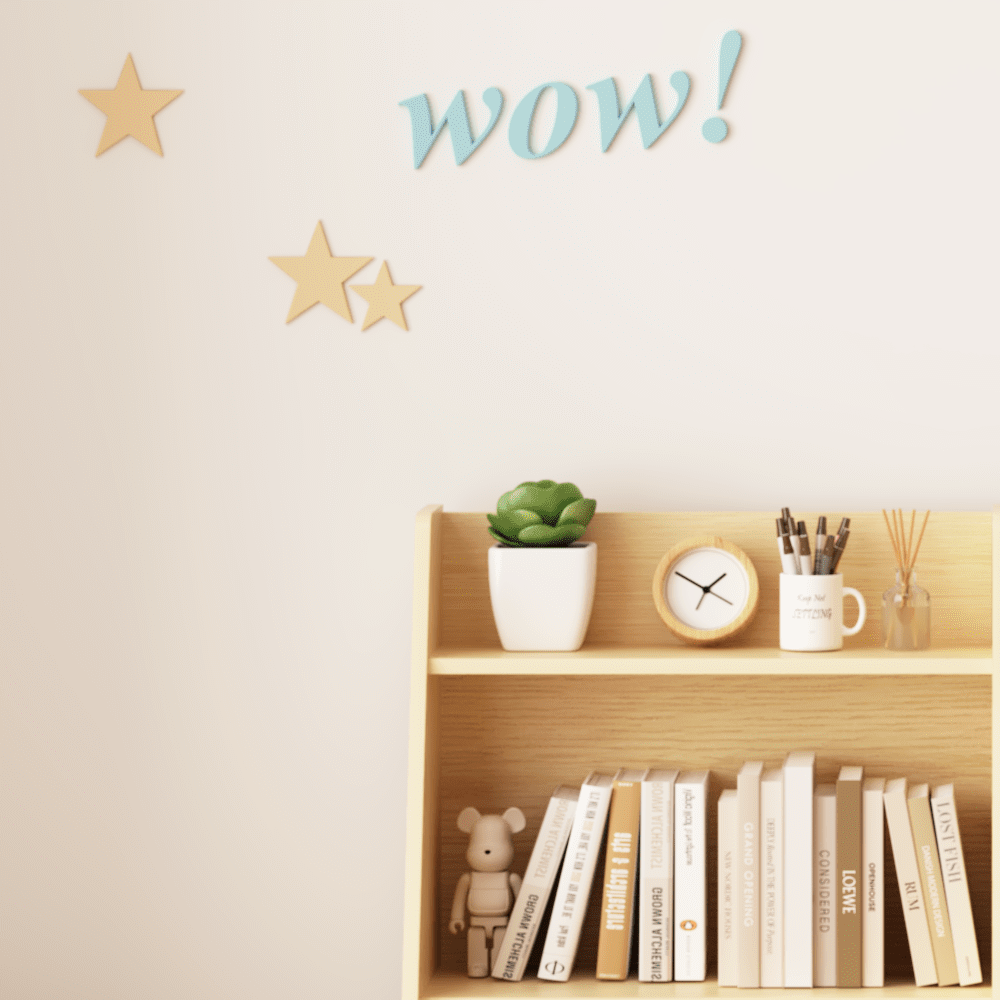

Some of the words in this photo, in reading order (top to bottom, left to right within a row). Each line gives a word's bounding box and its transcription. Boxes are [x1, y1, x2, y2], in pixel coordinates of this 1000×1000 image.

[398, 30, 742, 169] wow!
[743, 821, 753, 865] GRAND
[936, 802, 954, 843] LOST
[945, 846, 962, 883] FISH
[743, 870, 753, 926] OPENING
[819, 849, 830, 932] CONSIDERED
[842, 870, 856, 914] LOEWE
[904, 880, 920, 911] RUM
